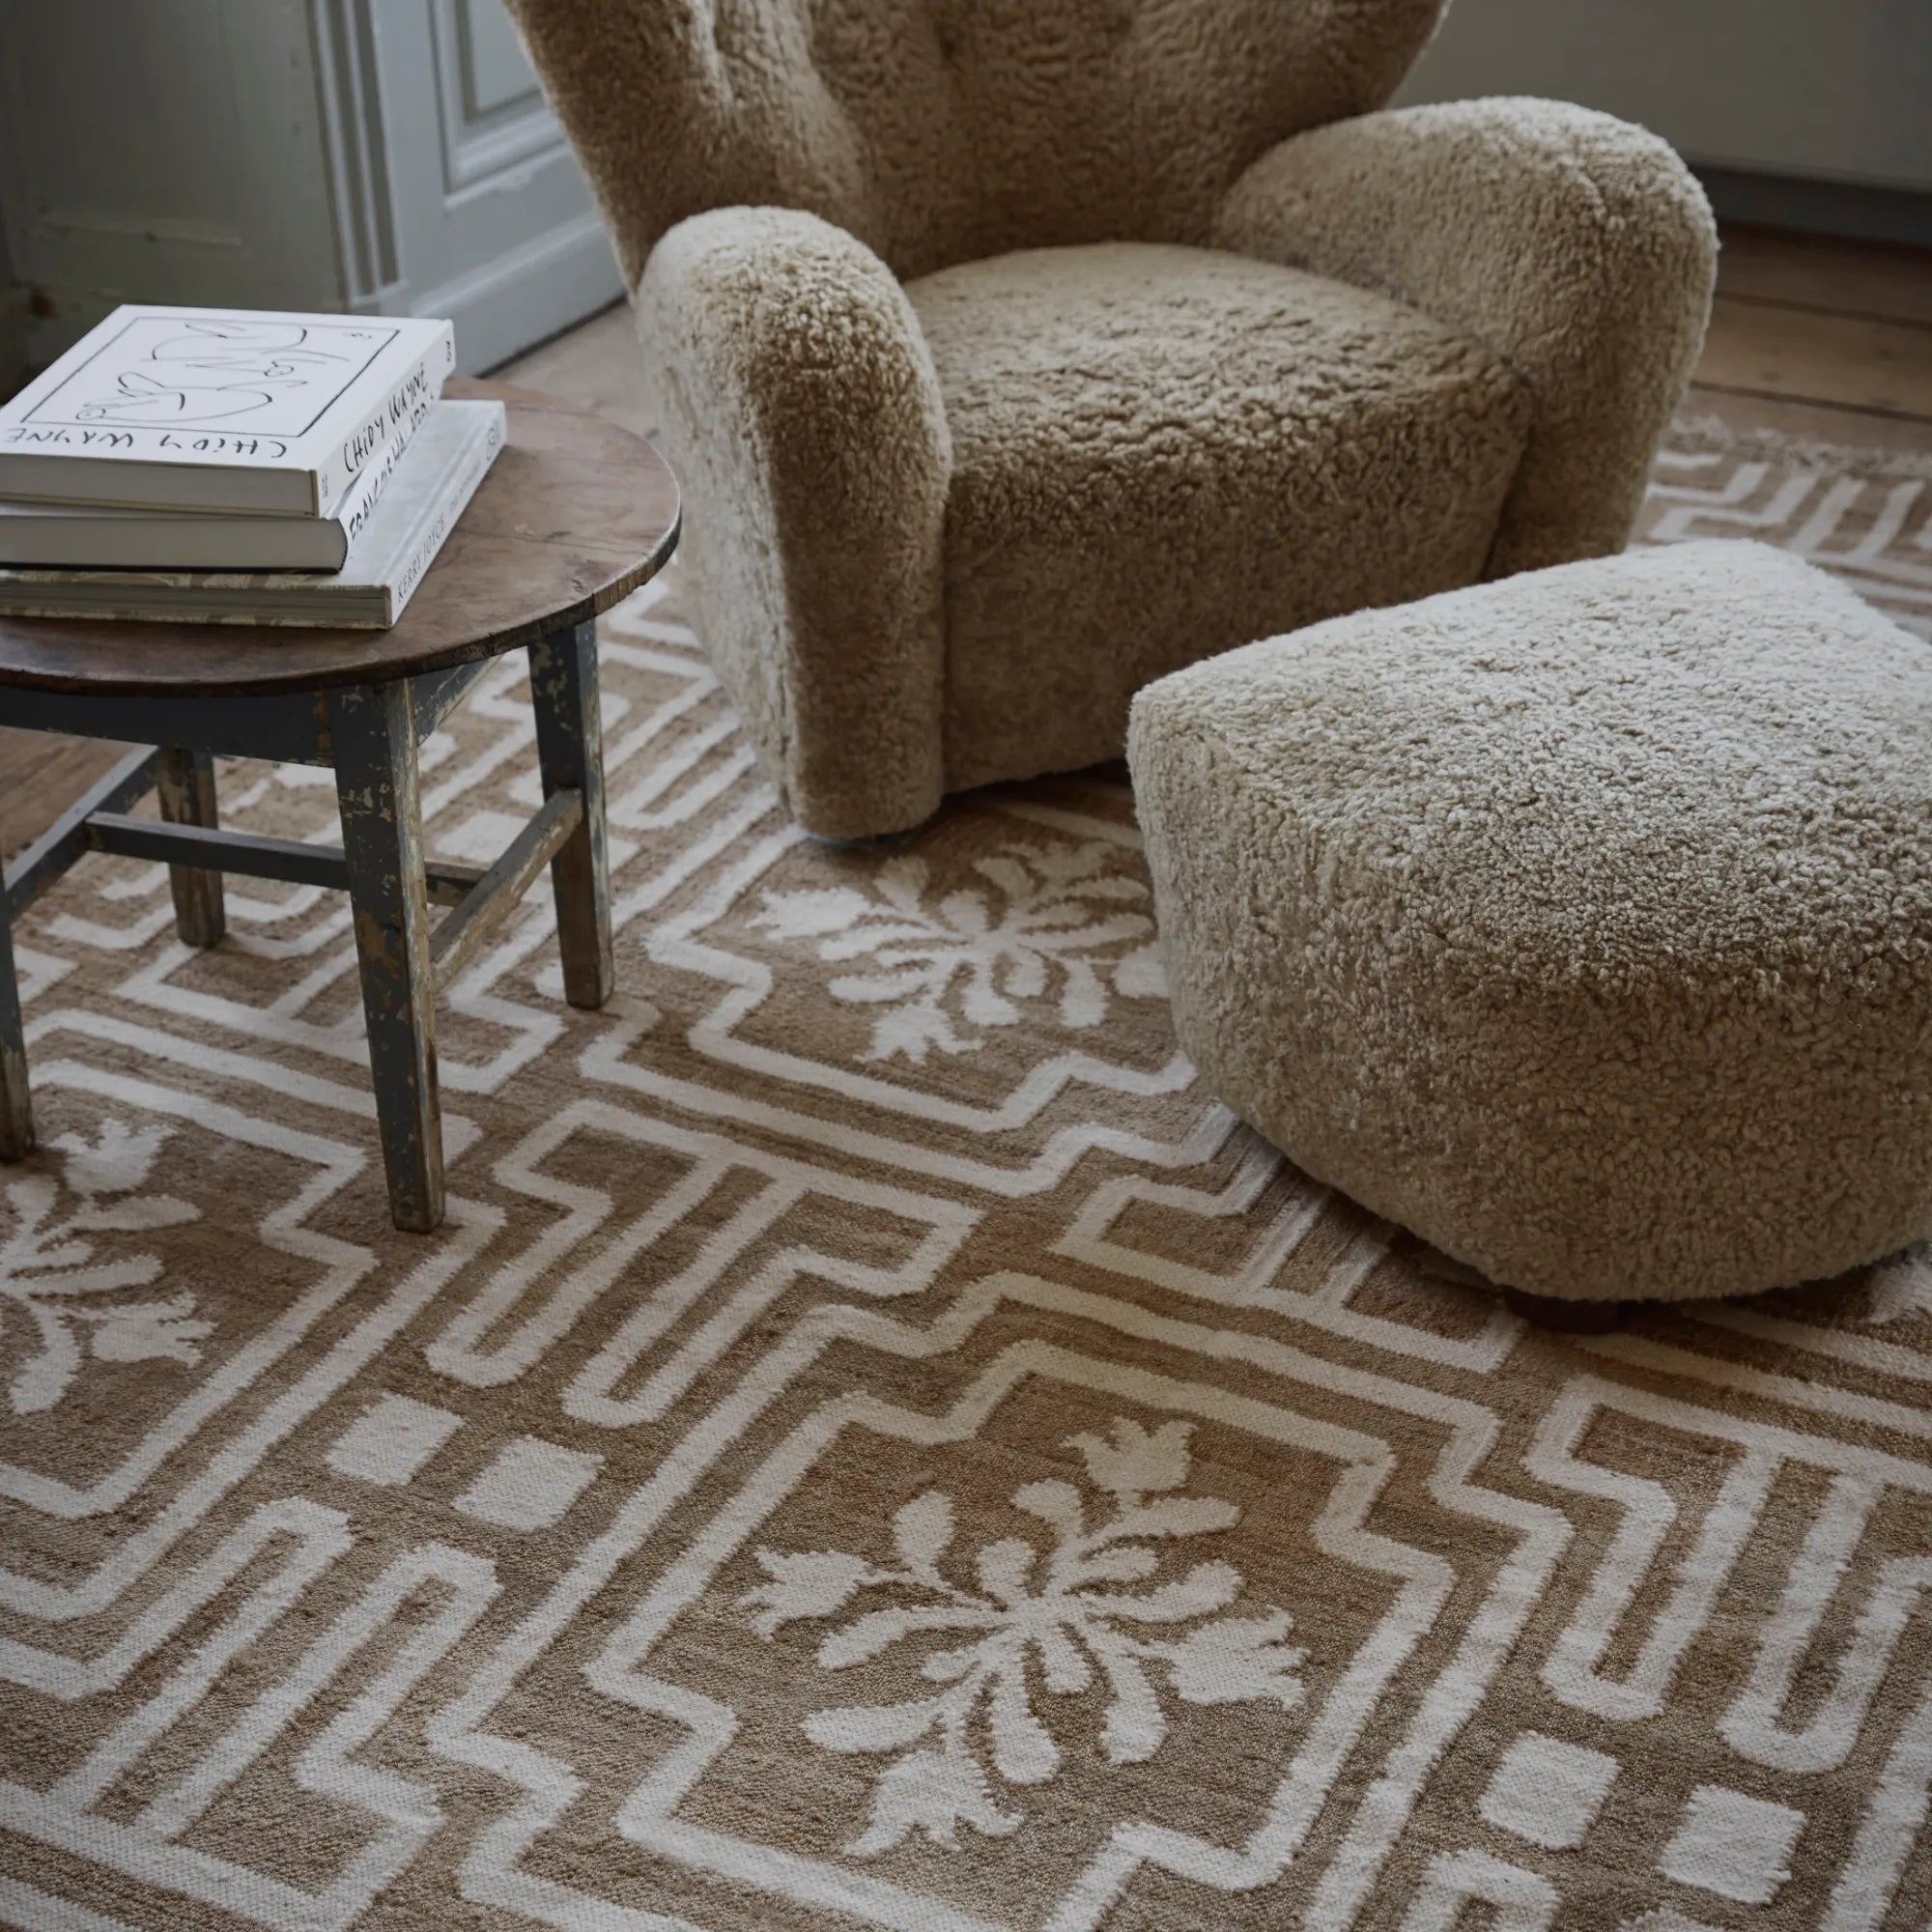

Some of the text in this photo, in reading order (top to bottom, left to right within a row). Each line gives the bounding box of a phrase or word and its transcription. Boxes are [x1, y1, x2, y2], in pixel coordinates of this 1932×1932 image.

[388, 362, 428, 424] WAYNE
[5, 428, 133, 448] WAYNE
[397, 511, 445, 603] KERRY JOYCE
